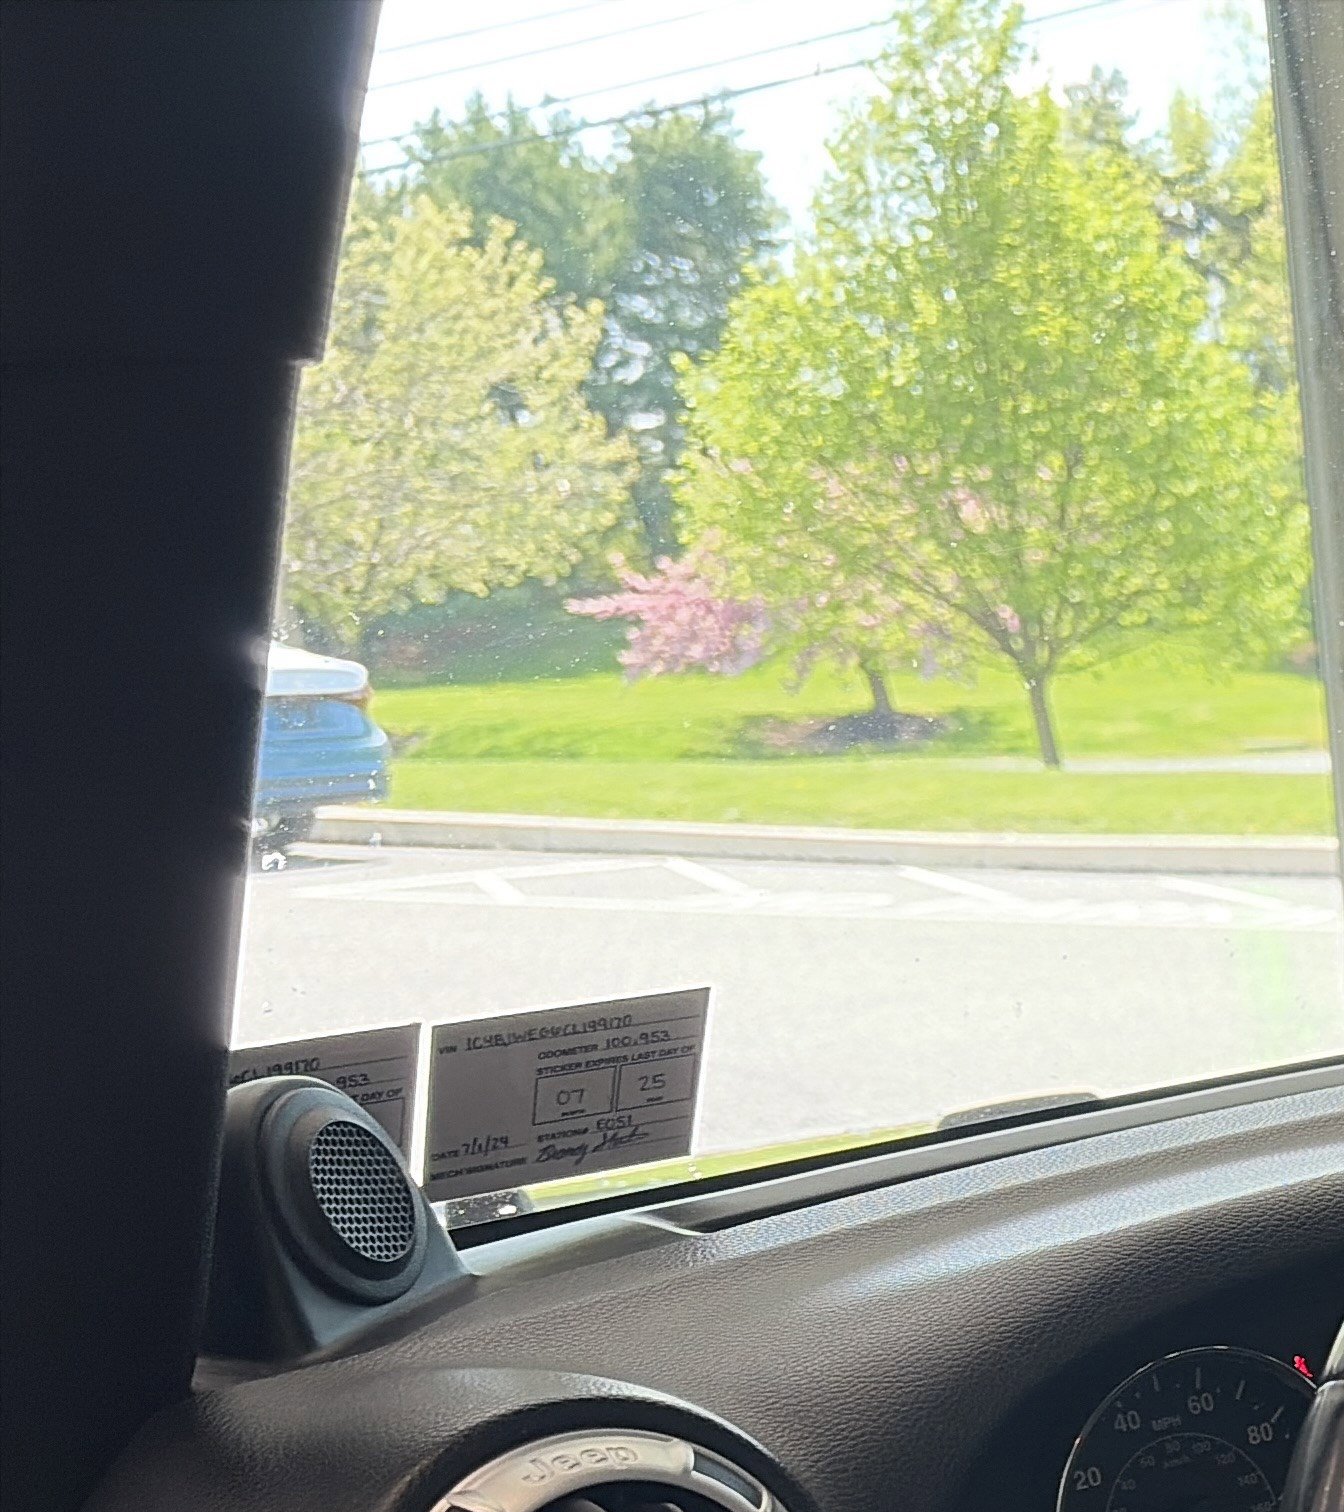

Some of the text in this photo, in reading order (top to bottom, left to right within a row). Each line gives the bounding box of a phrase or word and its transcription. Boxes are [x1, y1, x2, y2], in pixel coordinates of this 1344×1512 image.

[631, 1049, 657, 1062] LAST
[638, 1073, 667, 1092] 25
[556, 1088, 585, 1106] 07
[1187, 1393, 1214, 1415] 60
[1113, 1410, 1141, 1432] 40
[1151, 1415, 1182, 1431] MPH
[1247, 1422, 1273, 1445] 80
[521, 1441, 639, 1486] Jeep
[1073, 1467, 1102, 1491] 20
